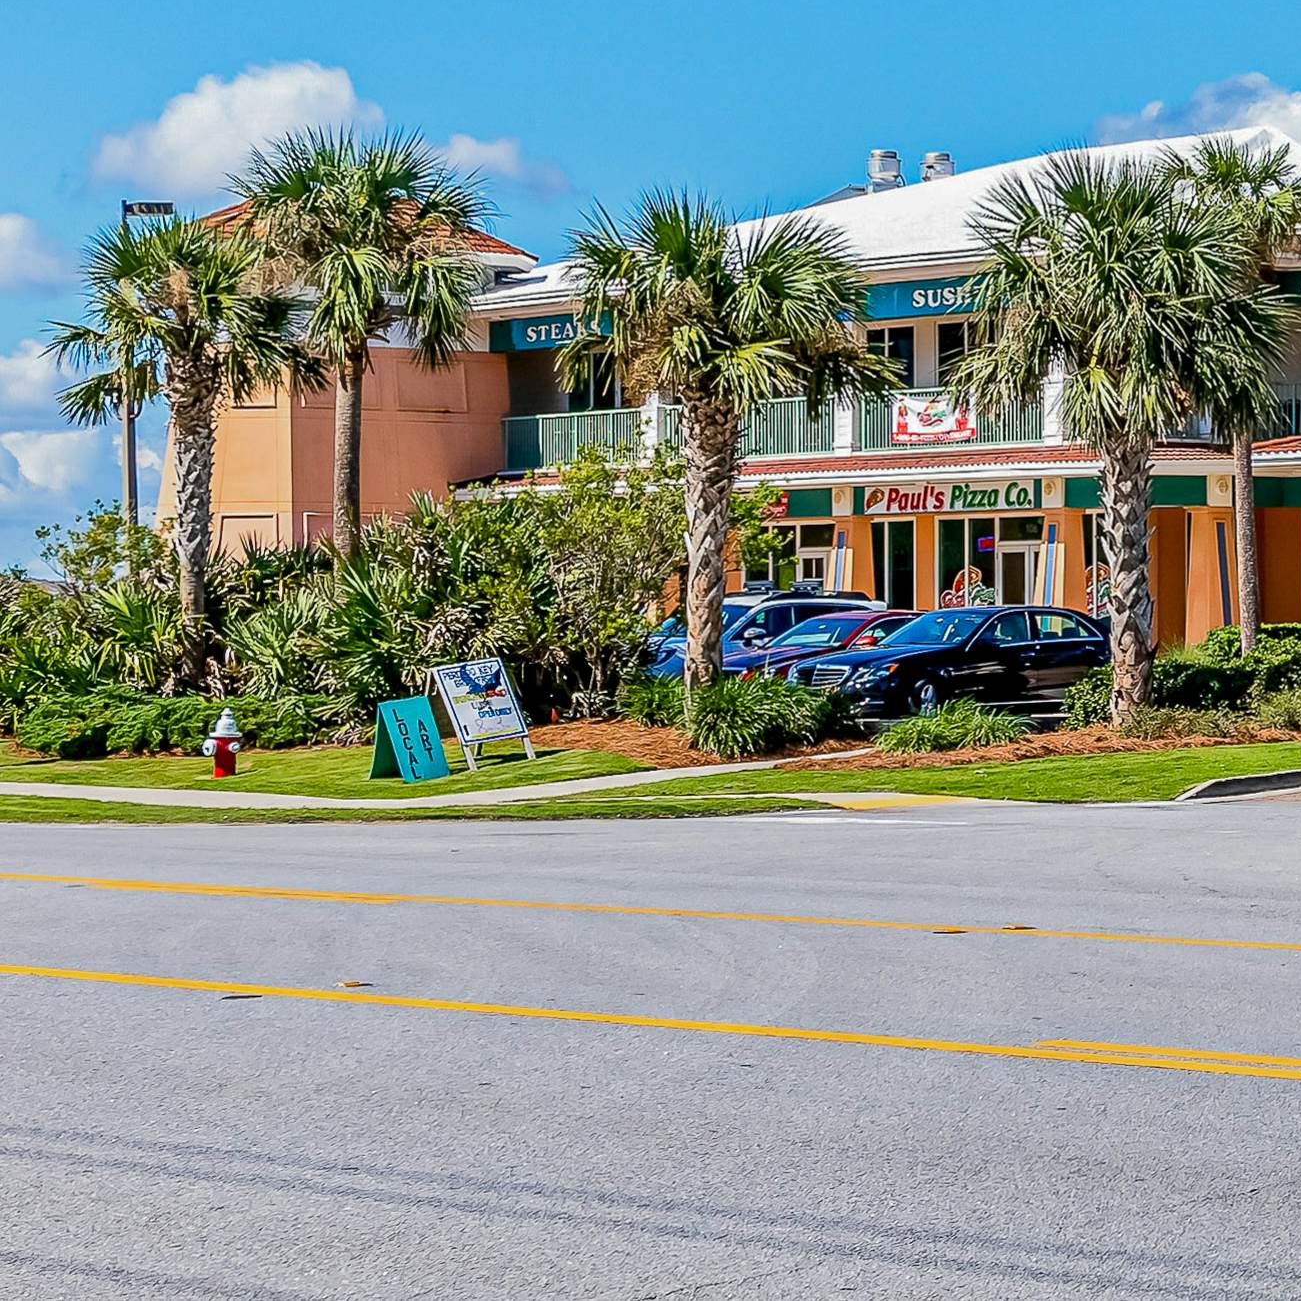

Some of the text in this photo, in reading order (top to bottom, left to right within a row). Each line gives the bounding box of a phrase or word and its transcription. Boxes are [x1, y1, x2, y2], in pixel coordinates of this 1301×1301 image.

[912, 285, 979, 308] SUSH
[886, 481, 1033, 512] Paul's Pizza Co.
[391, 708, 423, 780] LOCAL
[418, 718, 434, 762] ART
